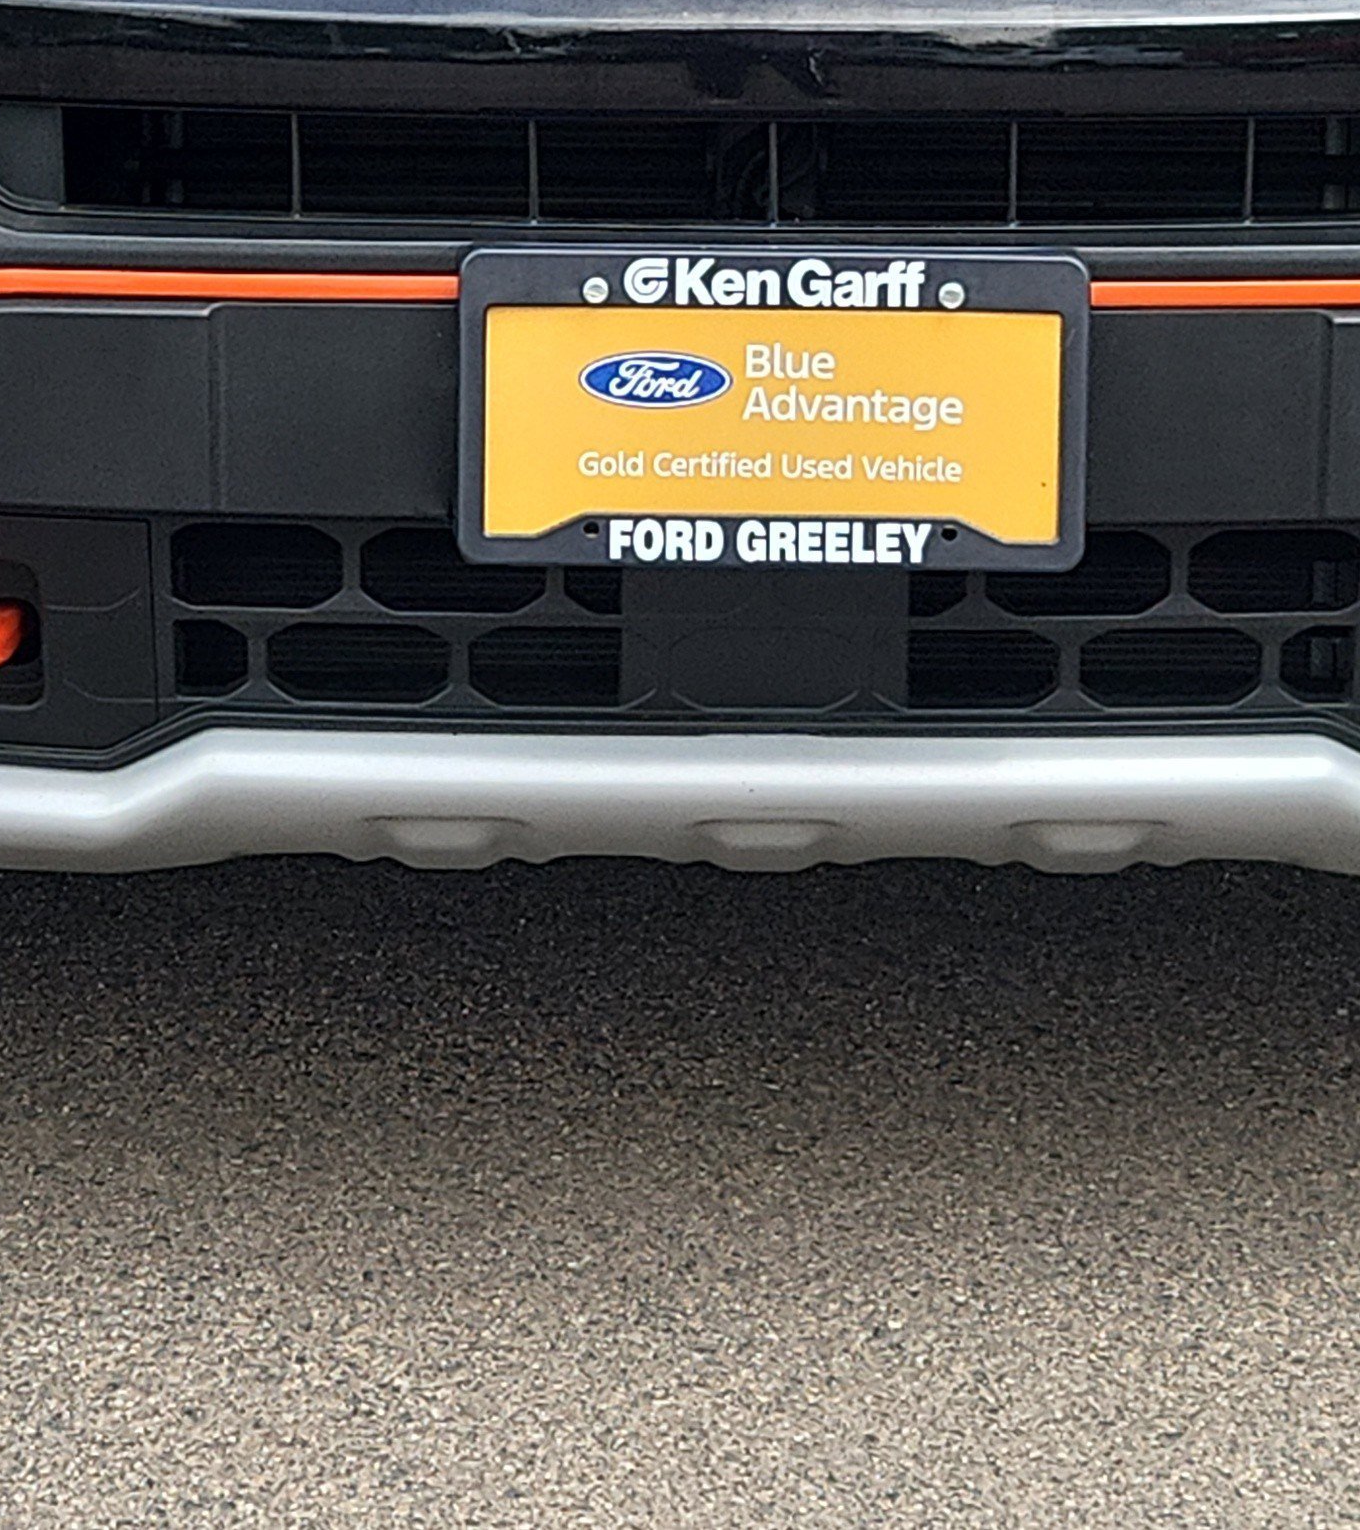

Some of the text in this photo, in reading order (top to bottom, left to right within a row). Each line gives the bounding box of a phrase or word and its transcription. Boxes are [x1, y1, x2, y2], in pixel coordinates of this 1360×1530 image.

[674, 259, 926, 308] Ken Garff
[607, 359, 701, 398] Ford
[744, 344, 835, 379] Blue
[742, 387, 964, 431] Advantage
[578, 451, 963, 482] Gold Certified Used Vehicle
[608, 520, 932, 564] FORD GREELEY
